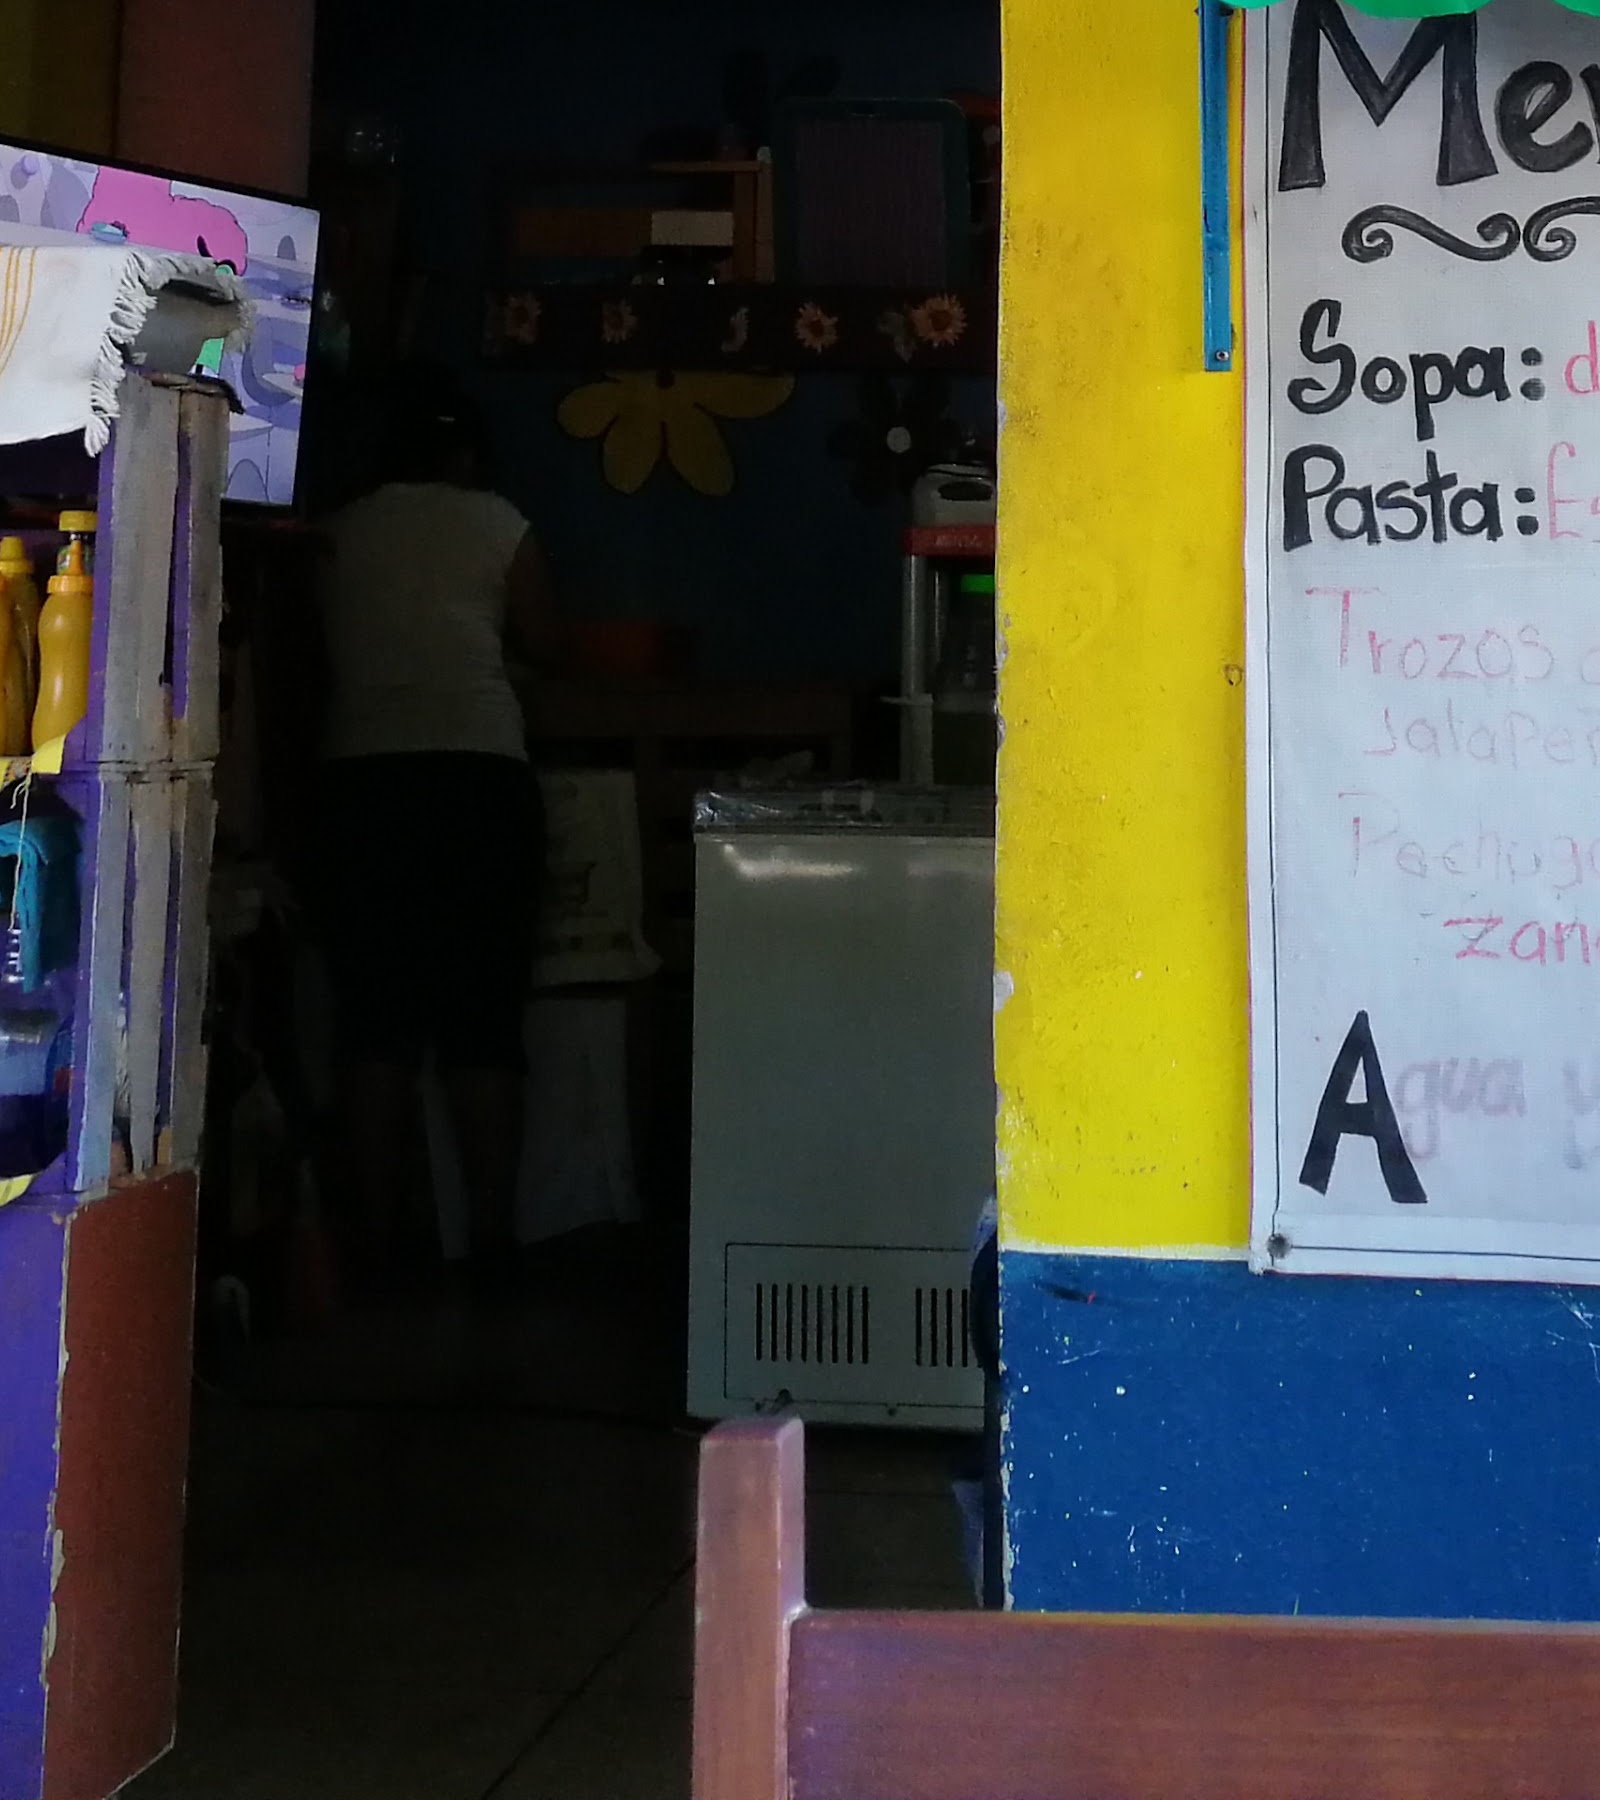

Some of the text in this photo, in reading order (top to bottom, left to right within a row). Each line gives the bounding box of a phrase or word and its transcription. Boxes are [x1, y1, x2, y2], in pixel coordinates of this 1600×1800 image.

[1287, 298, 1546, 441] Sopa:
[1283, 443, 1540, 552] Pasta:
[1304, 586, 1556, 682] Trozos
